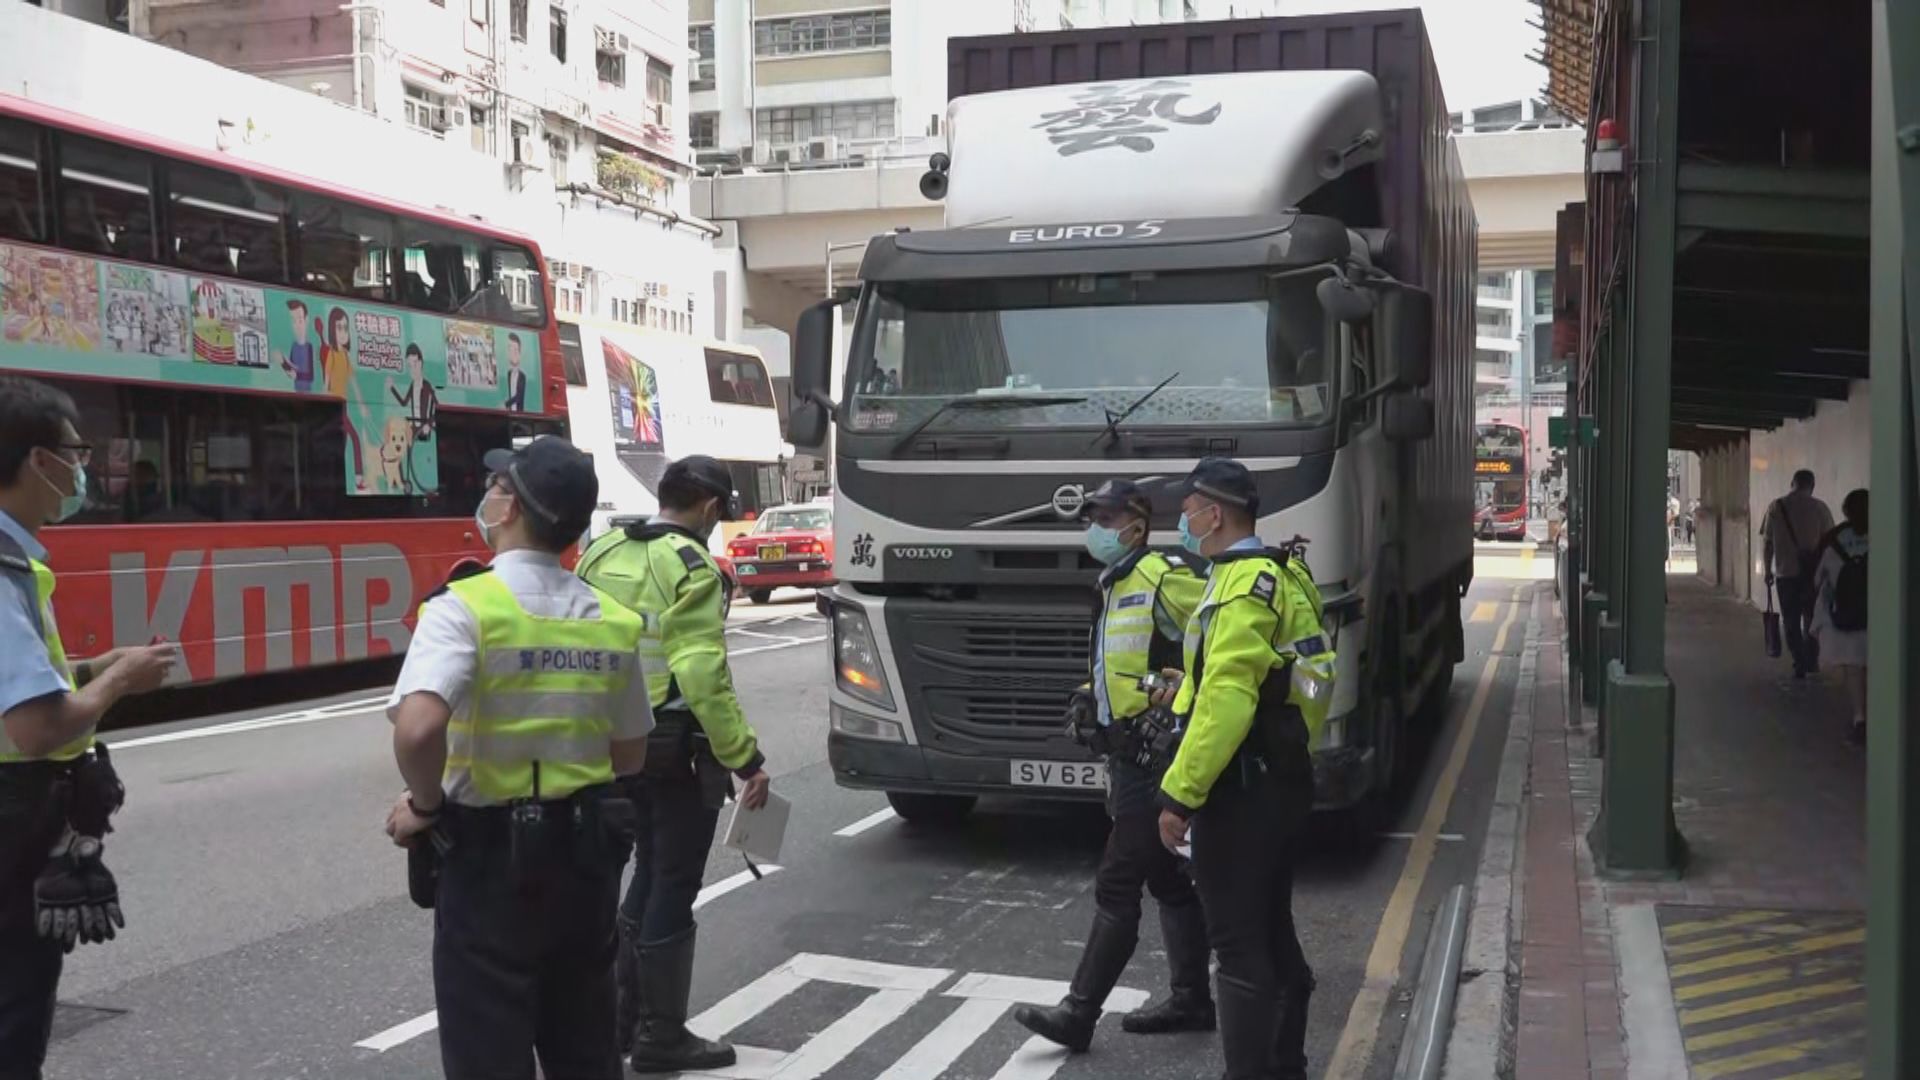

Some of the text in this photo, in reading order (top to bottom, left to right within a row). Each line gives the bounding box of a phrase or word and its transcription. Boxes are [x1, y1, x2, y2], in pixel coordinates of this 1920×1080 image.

[1008, 224, 1125, 243] EURO
[356, 312, 400, 337] 共融香港
[358, 337, 401, 357] Inclusive
[358, 352, 402, 371] Hong Kong
[850, 533, 876, 568] 萬
[893, 547, 954, 560] VOLVO
[109, 542, 415, 688] KMB
[542, 650, 601, 671] POLICE
[1020, 763, 1105, 787] SV 62
